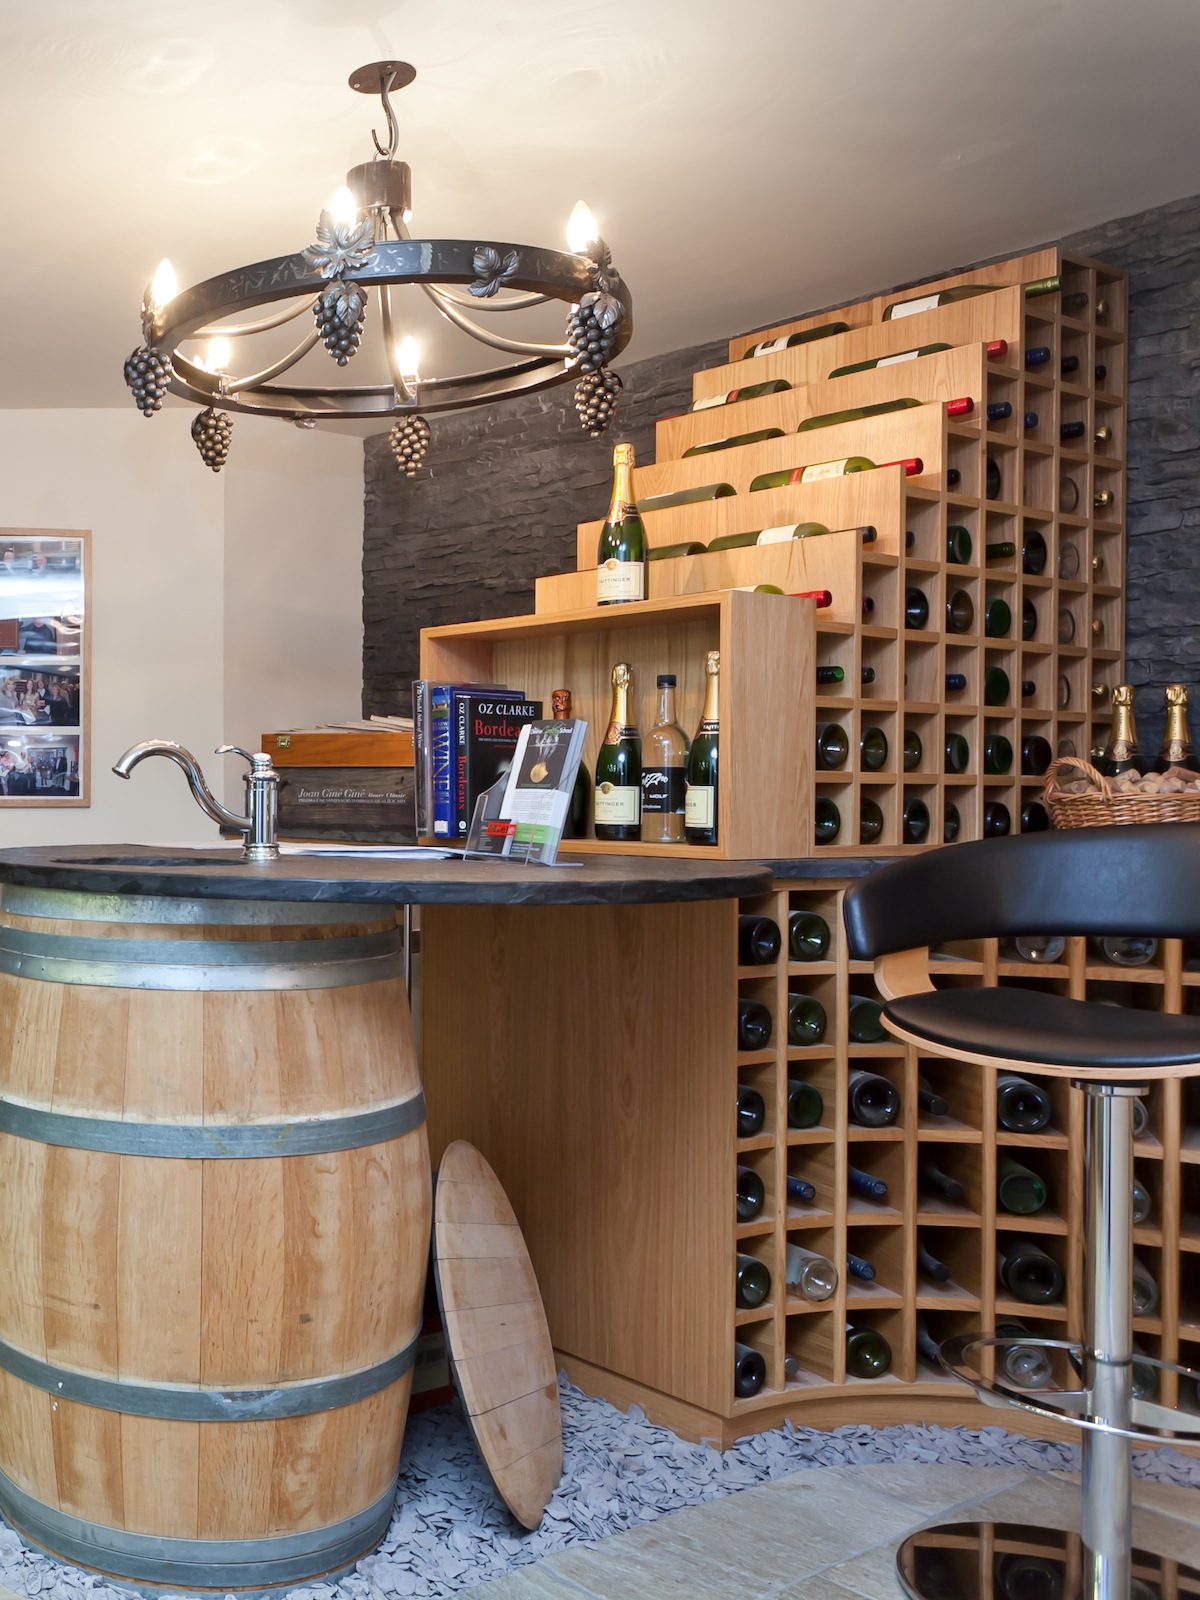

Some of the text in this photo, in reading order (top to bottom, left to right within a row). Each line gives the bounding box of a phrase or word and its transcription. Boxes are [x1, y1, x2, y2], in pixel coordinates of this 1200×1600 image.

[458, 702, 465, 714] OZ
[478, 703, 535, 717] OZ CLARKE
[474, 719, 520, 737] Bordea
[432, 731, 450, 790] WINE
[458, 756, 468, 810] Bordeaux
[298, 788, 320, 798] Joan
